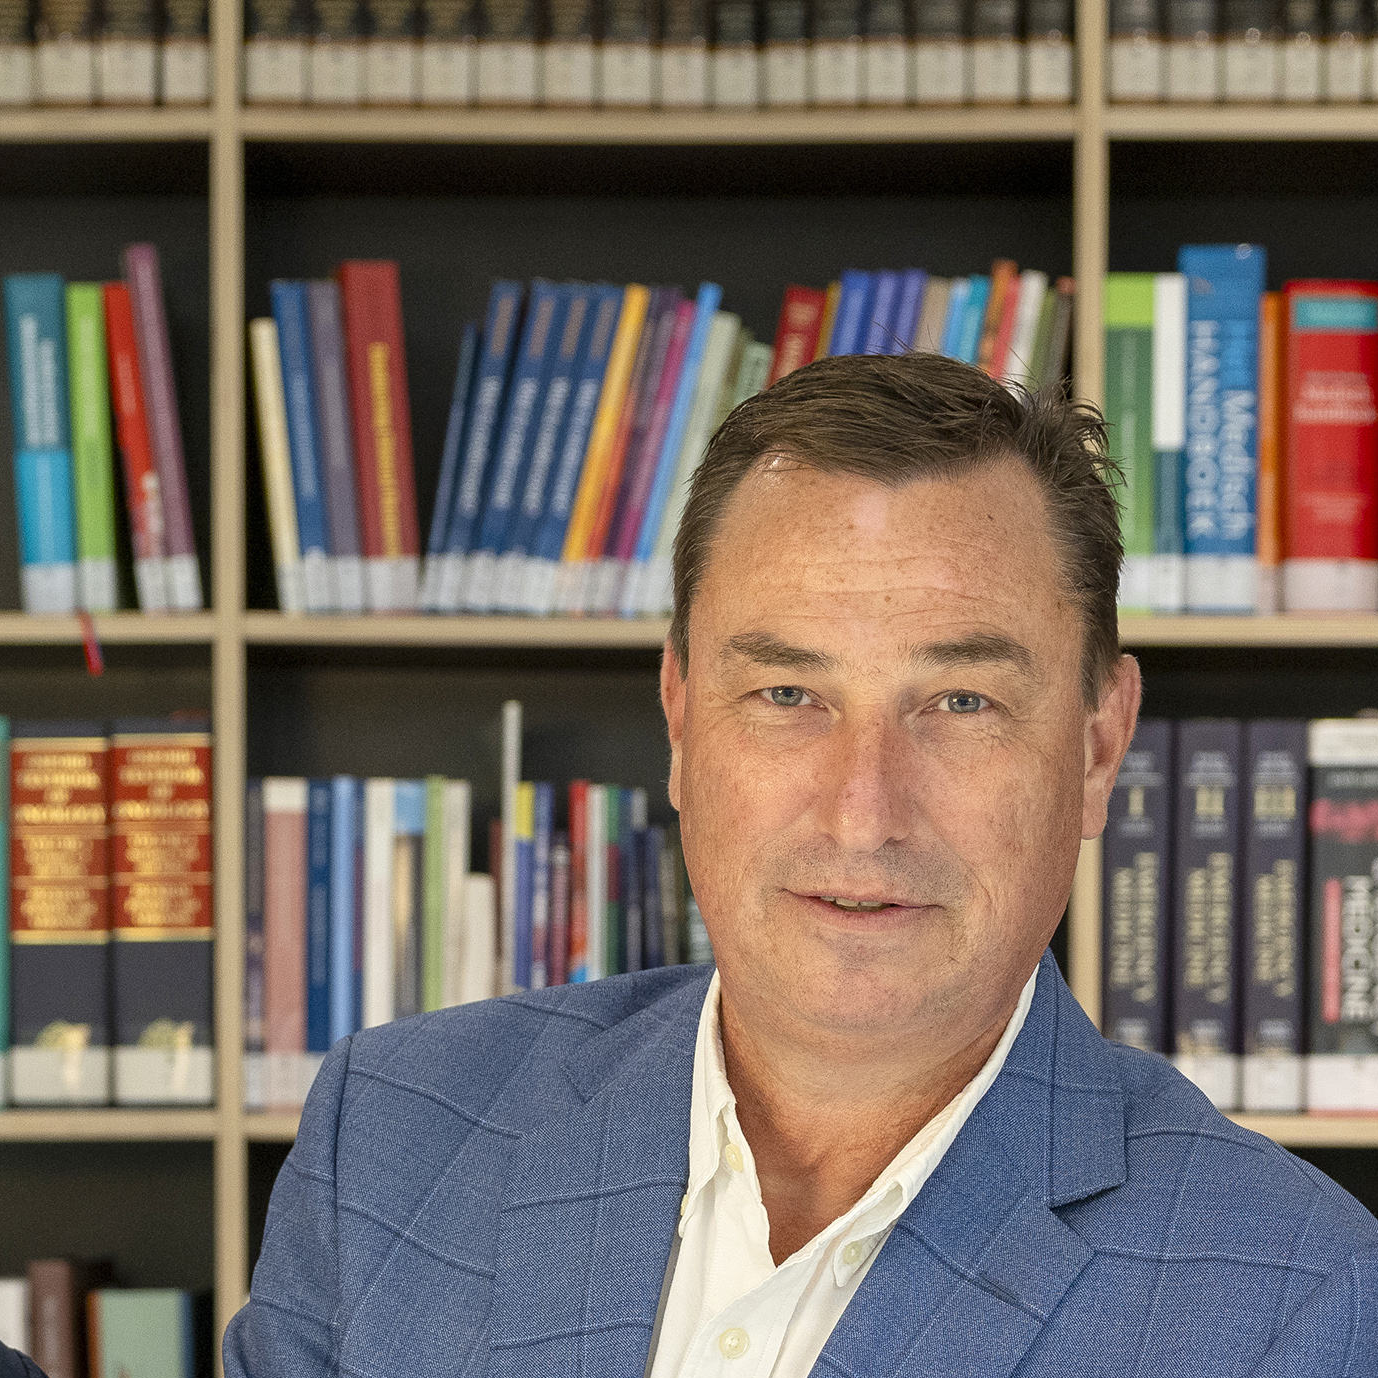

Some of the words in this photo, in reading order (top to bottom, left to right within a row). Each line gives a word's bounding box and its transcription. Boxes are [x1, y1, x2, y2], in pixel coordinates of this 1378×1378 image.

[1188, 322, 1218, 537] HANDBOEK
[1220, 392, 1254, 537] Medisch
[1343, 876, 1370, 1022] MEDICINE
